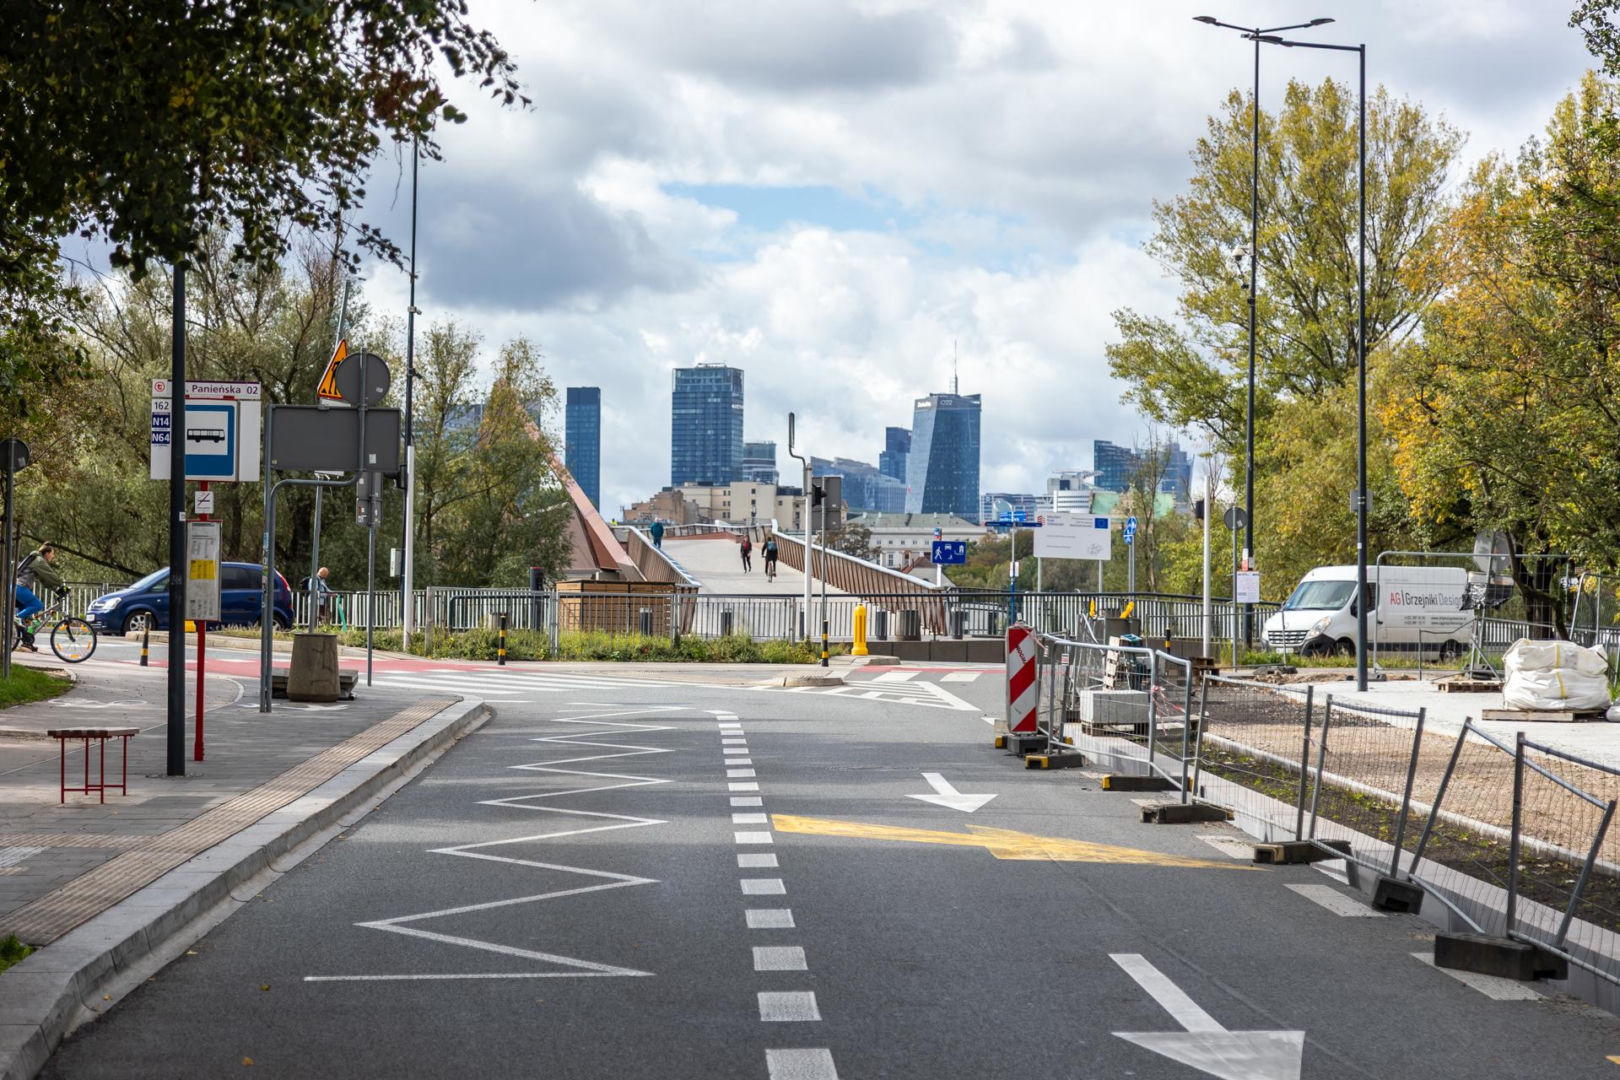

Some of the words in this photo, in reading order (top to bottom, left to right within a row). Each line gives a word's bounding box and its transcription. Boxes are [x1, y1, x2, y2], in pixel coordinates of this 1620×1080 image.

[192, 384, 241, 394] Panieńska
[246, 386, 258, 395] 02
[154, 402, 169, 410] 162
[152, 417, 169, 426] N14
[152, 433, 170, 442] N64
[1390, 592, 1401, 606] AG
[1405, 592, 1437, 608] Grzejniki
